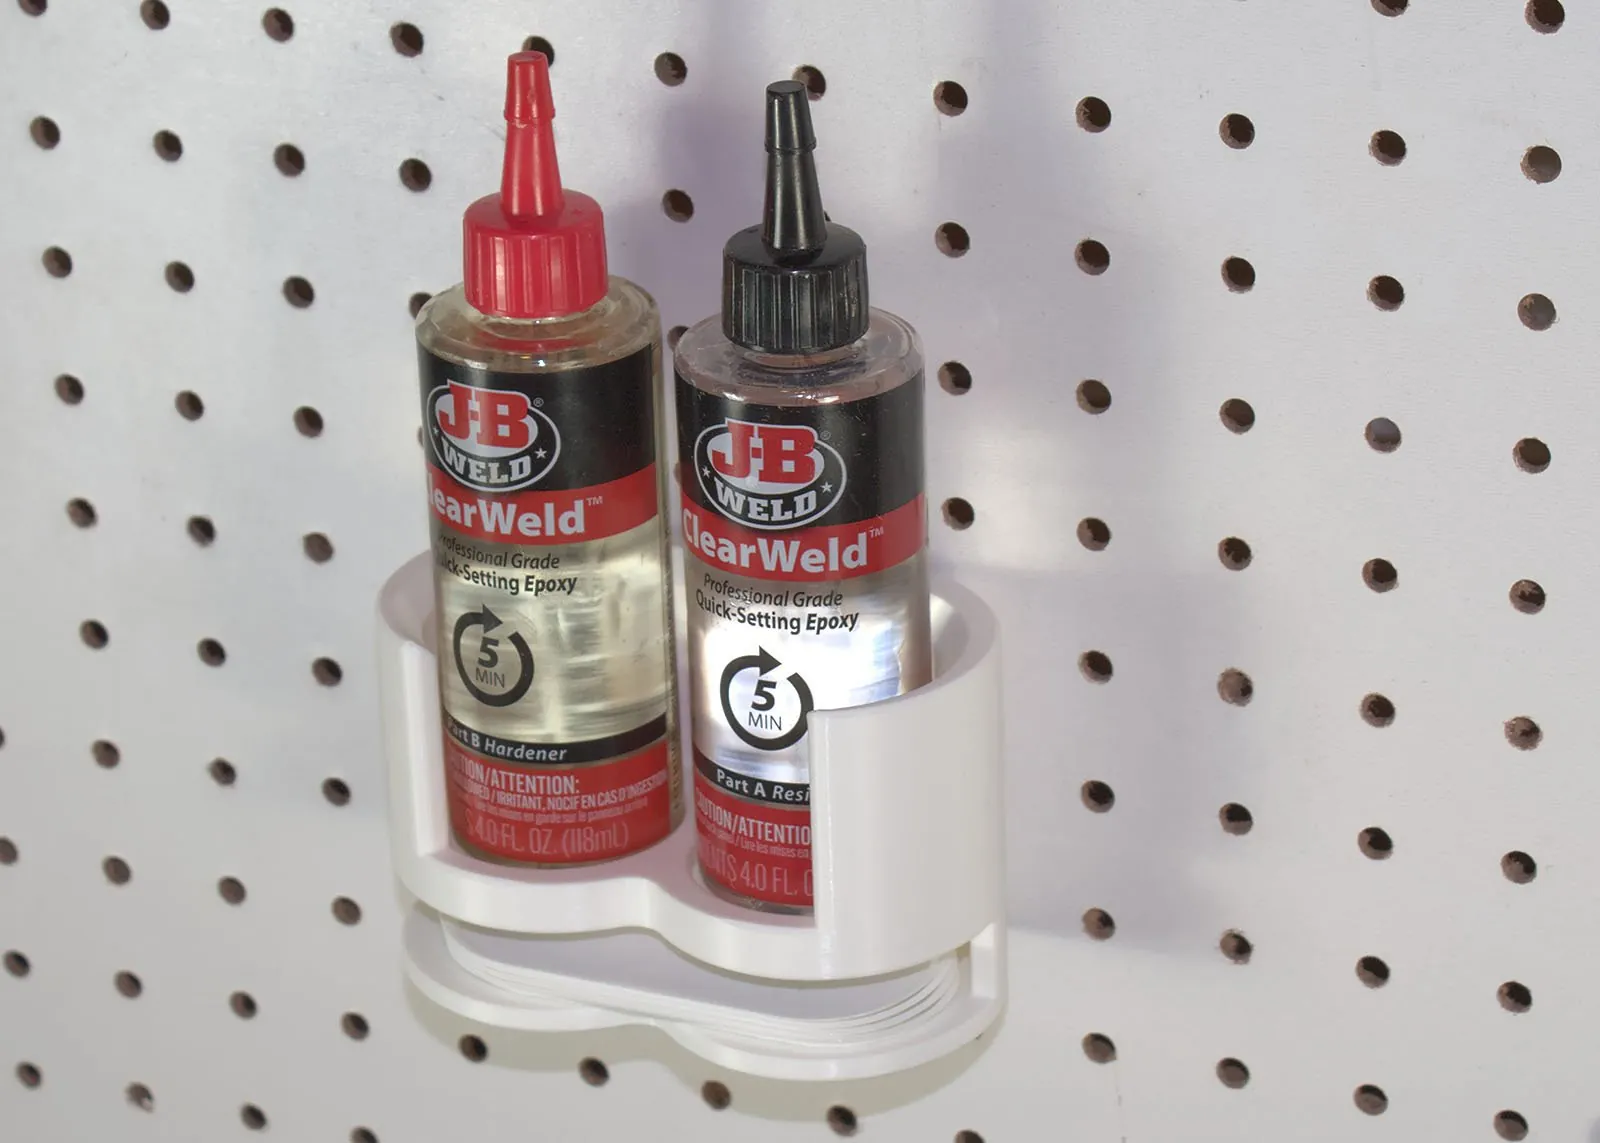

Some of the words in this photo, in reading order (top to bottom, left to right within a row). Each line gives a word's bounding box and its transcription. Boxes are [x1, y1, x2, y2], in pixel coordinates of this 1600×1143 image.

[441, 436, 531, 484] WELD
[428, 473, 585, 537] learWeld
[714, 476, 817, 522] WELD
[682, 507, 868, 573] ClearWeld
[441, 551, 519, 595] ick-Setting
[524, 575, 578, 596] Epoxy
[511, 553, 560, 569] Grade
[703, 572, 788, 607] Professional
[793, 590, 843, 608] Grade
[695, 588, 801, 635] Quick-Setting
[805, 611, 859, 635] Epoxy
[477, 636, 499, 668] 5
[475, 668, 505, 688] MIN
[751, 679, 777, 712] 5
[748, 711, 782, 731] MIN
[471, 732, 480, 748] B
[484, 737, 568, 761] Hardener
[547, 795, 580, 811] NOCIF
[581, 794, 596, 809] EN
[597, 788, 619, 806] CAS
[716, 768, 749, 793] Part
[754, 782, 766, 798] A
[772, 785, 811, 802] Resi
